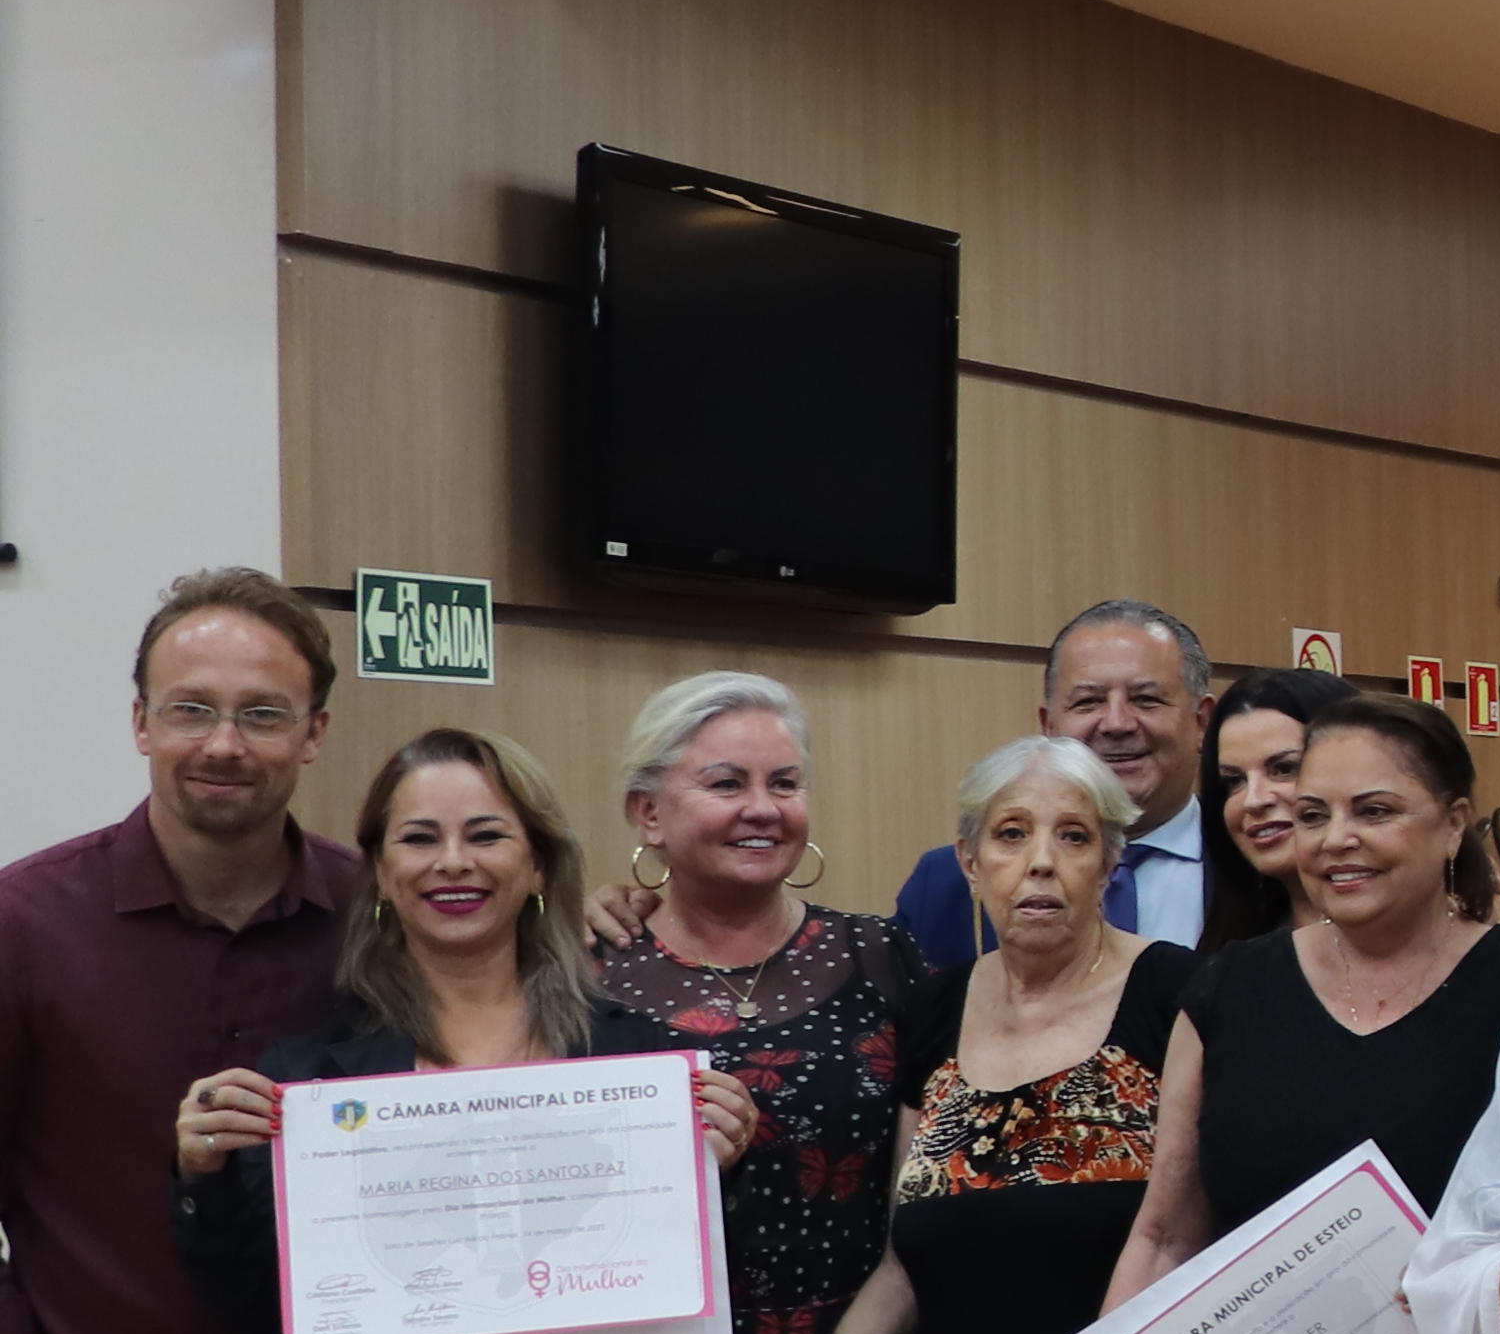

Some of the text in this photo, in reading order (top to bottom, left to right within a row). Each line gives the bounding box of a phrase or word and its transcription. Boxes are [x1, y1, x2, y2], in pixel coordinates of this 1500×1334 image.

[425, 590, 487, 669] SAÍDA
[375, 1083, 659, 1121] CÂMARA MUNICIPAL DE ESTEIO
[359, 1160, 625, 1196] MARIA REGINA DOS SANTOS PAZ
[556, 1265, 646, 1296] Mulher
[1215, 1261, 1296, 1323] MUNICIPAL
[1294, 1241, 1317, 1262] DE
[1315, 1207, 1362, 1247] ESTEIO
